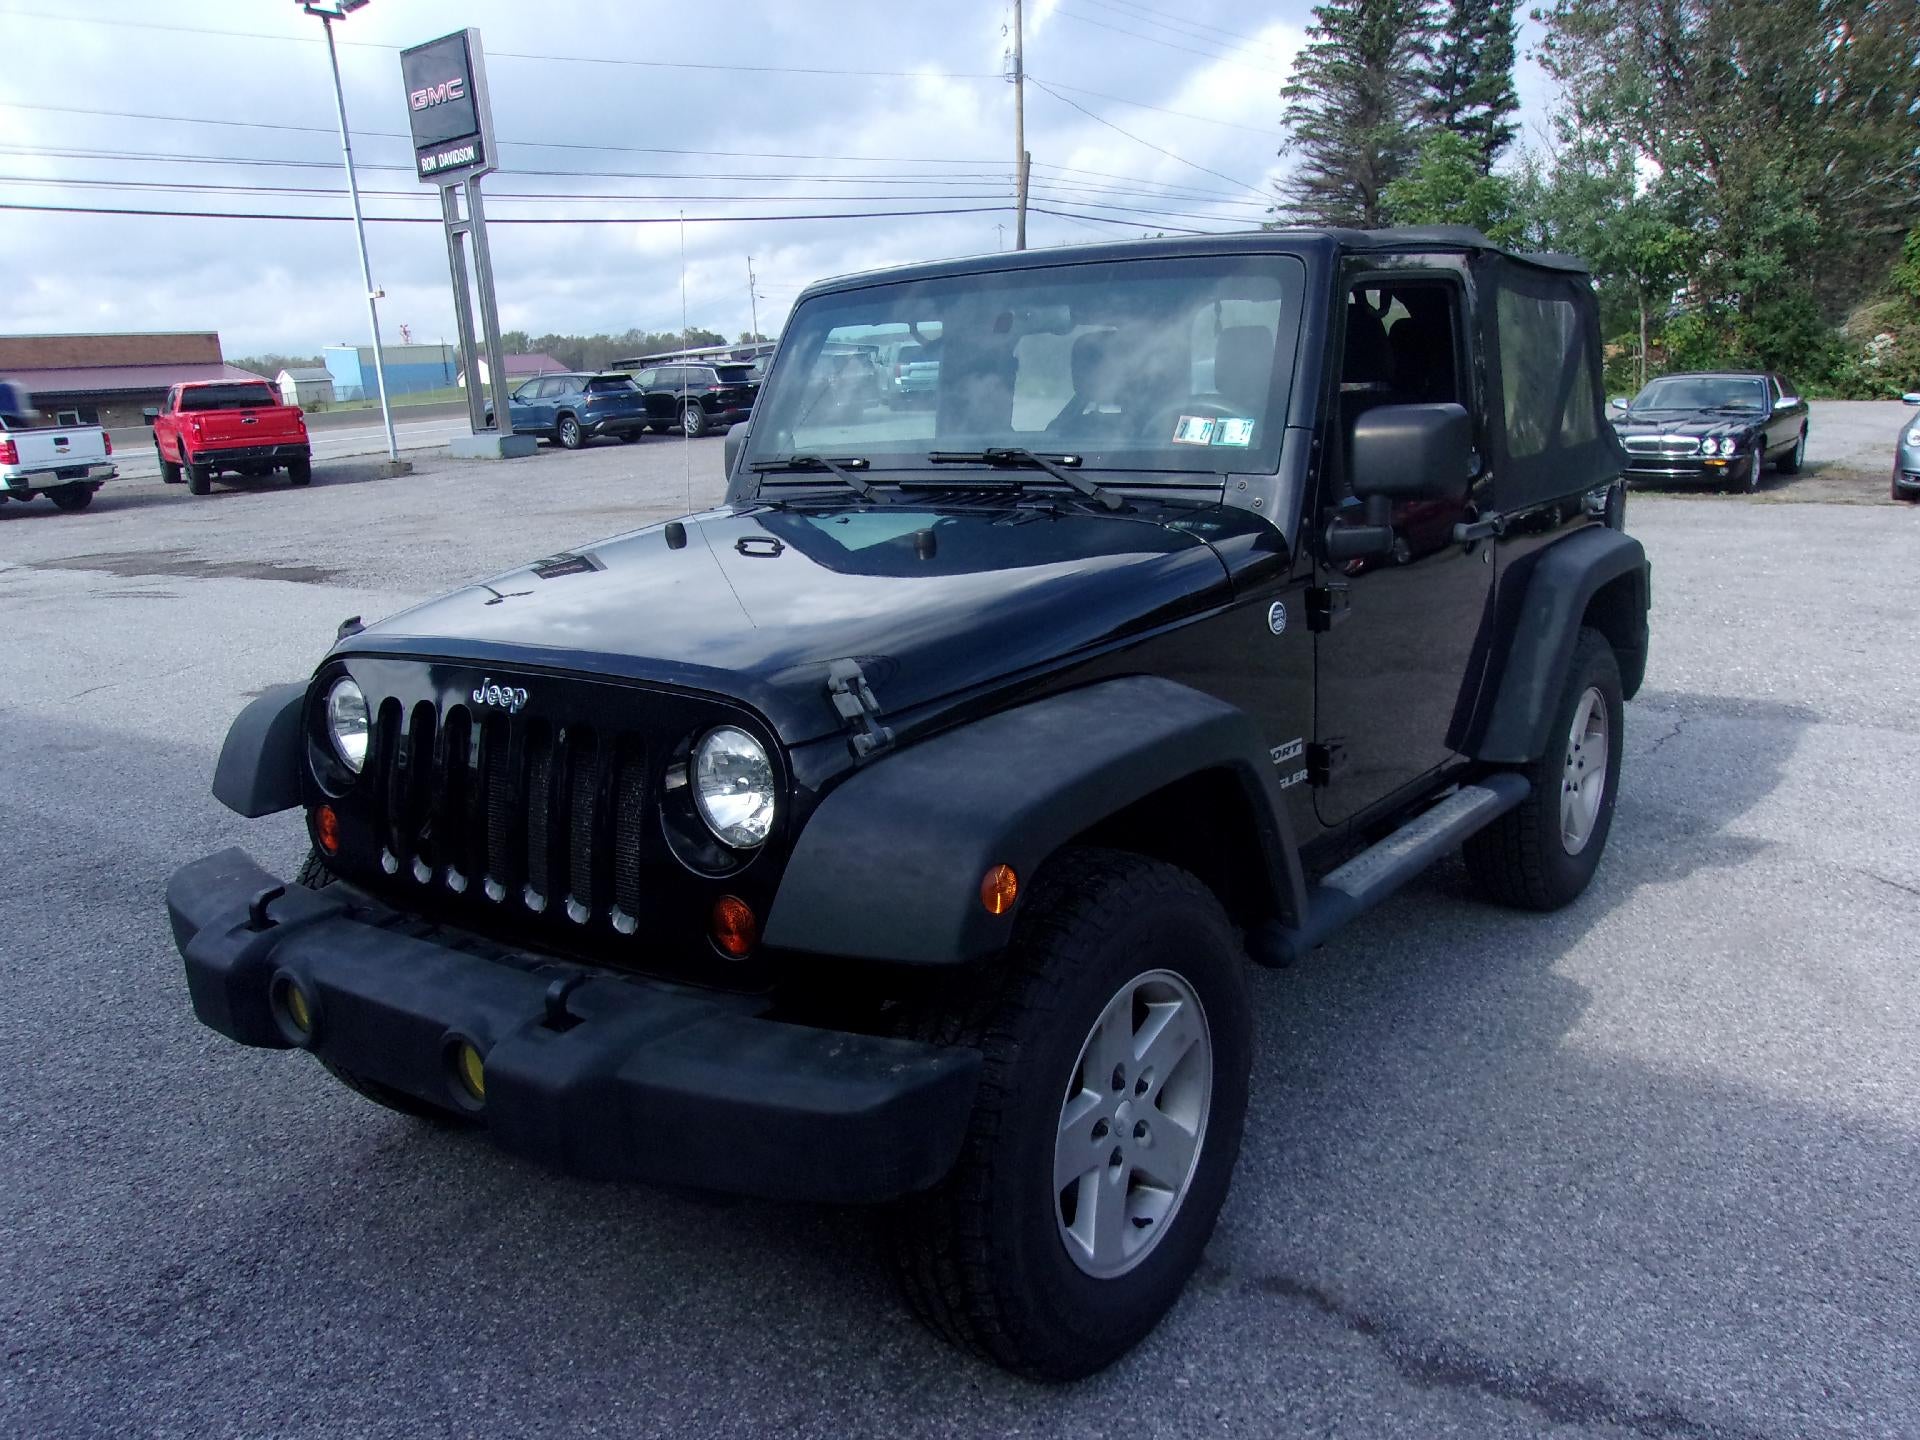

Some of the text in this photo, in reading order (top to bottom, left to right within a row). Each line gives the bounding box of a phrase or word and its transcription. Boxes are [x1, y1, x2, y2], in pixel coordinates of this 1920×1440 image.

[411, 78, 464, 111] GMC
[421, 146, 475, 172] RON DAVIDSON
[473, 677, 528, 714] Jeep
[1271, 739, 1302, 763] ORT
